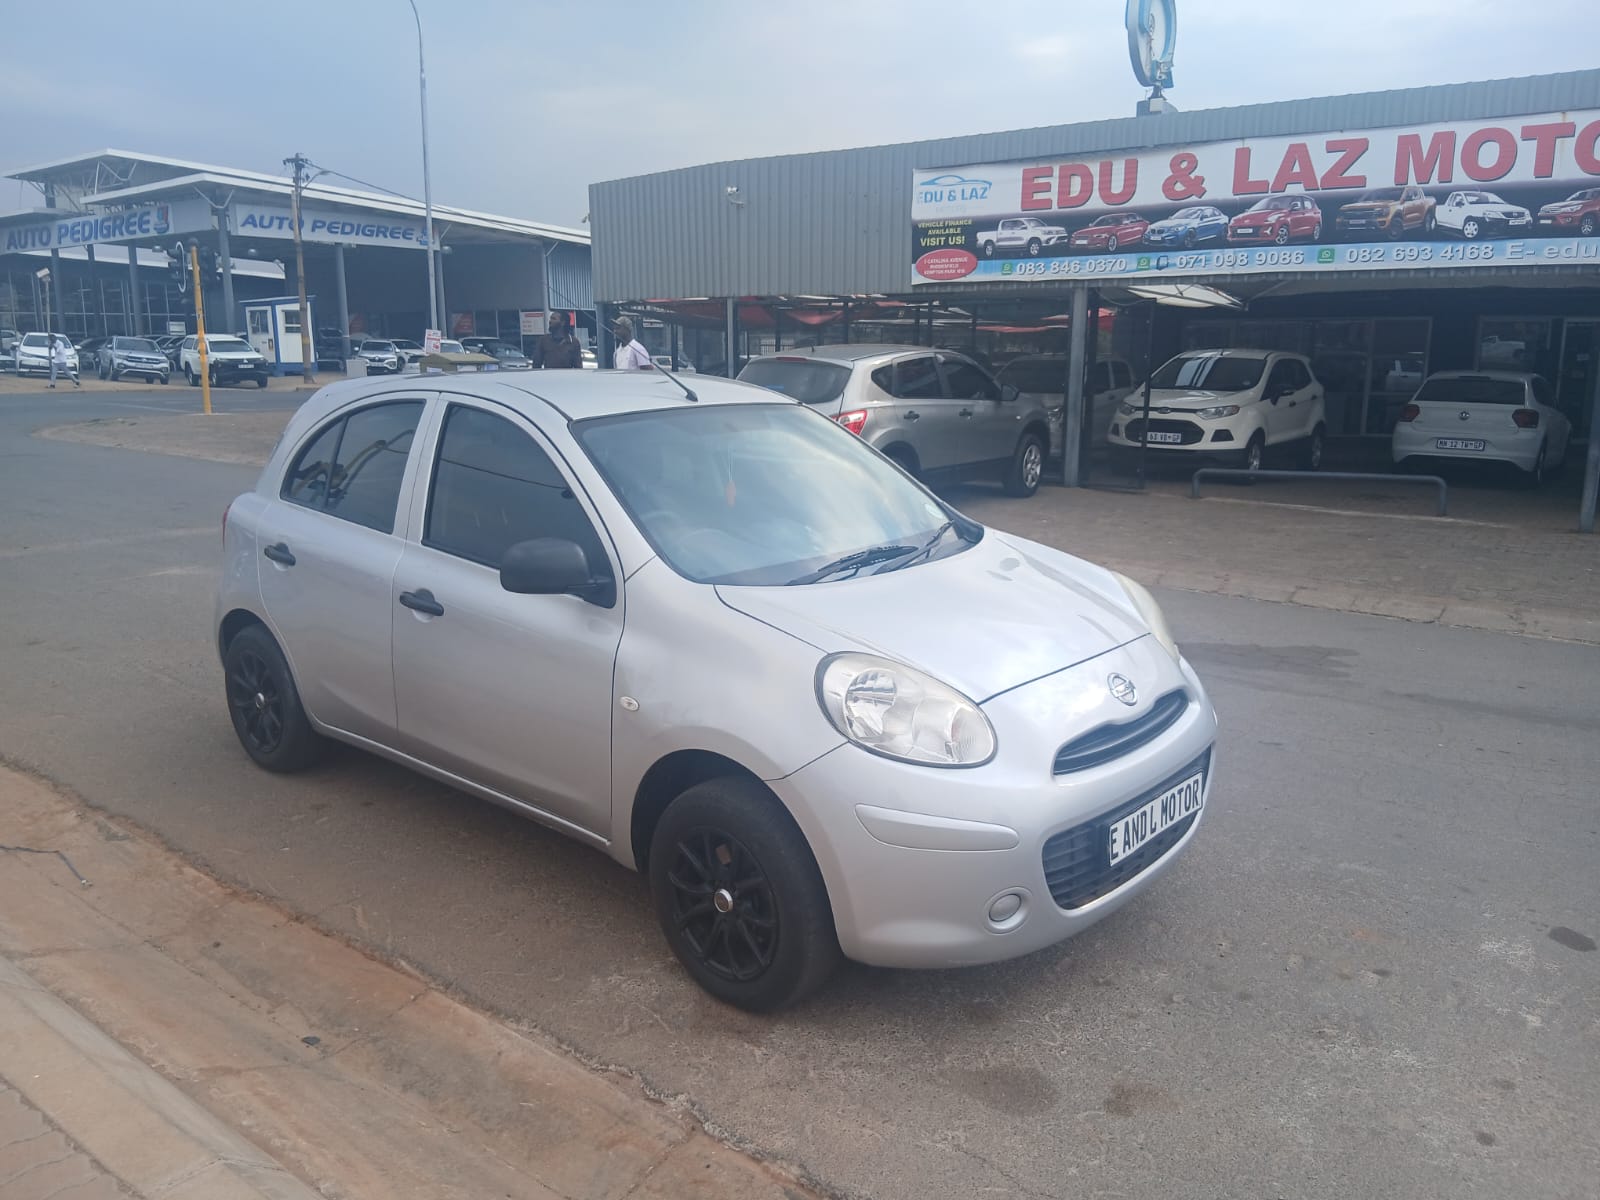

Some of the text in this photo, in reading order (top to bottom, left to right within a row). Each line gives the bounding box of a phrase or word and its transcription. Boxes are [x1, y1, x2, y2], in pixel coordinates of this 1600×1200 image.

[1021, 159, 1138, 211] EDU
[1162, 152, 1206, 201] &
[1232, 138, 1369, 195] LAZ
[948, 189, 956, 201] &
[961, 187, 988, 200] LAZ
[6, 210, 150, 250] AUTO PEDIGREE
[311, 219, 416, 241] PEDIGREE
[920, 236, 965, 247] VISIT US!
[1016, 262, 1045, 275] 083
[1050, 260, 1081, 274] 846
[1086, 258, 1127, 273] 0370
[1177, 254, 1206, 268] 071
[1214, 251, 1248, 267] 098
[1255, 250, 1304, 265] 9086
[1345, 247, 1385, 262] 082
[1393, 245, 1432, 261] 693
[1440, 243, 1494, 260] 4168
[1111, 779, 1199, 861] E AND L MOTOR
